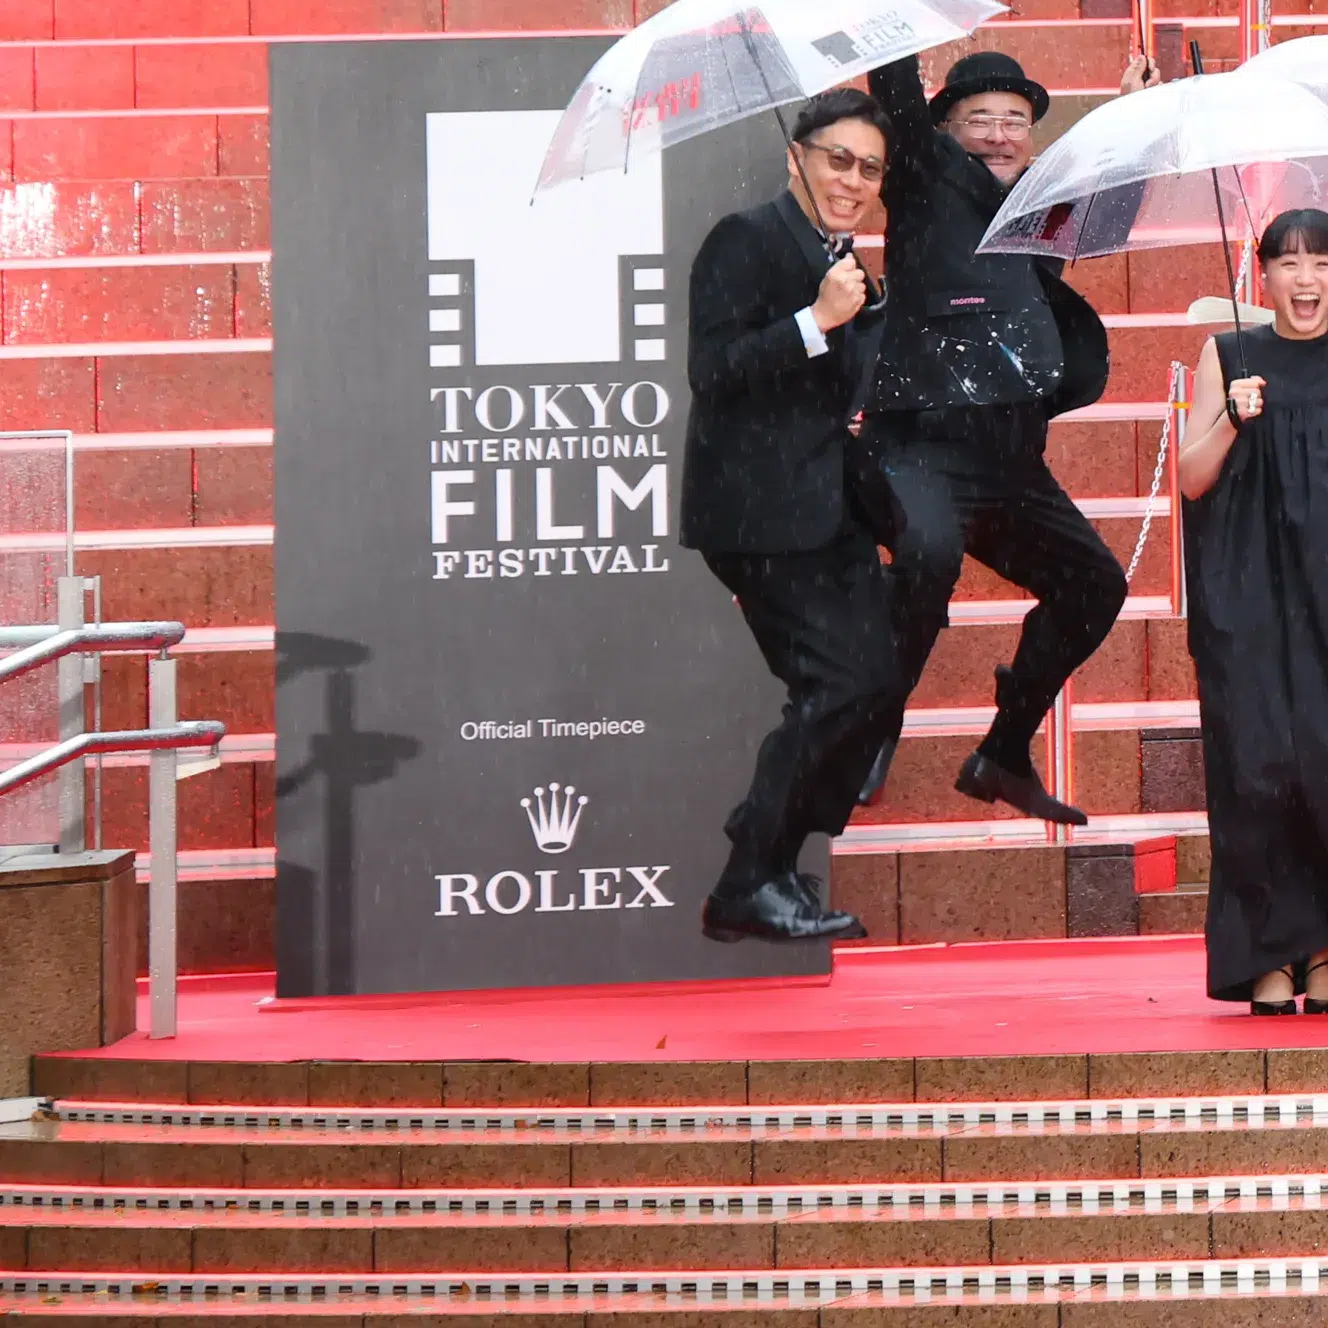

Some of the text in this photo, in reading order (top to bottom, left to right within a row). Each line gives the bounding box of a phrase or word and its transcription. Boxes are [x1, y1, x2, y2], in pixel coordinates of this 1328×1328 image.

[861, 21, 916, 53] FILM
[429, 380, 670, 434] TOKYO
[430, 433, 668, 464] INTERNATIONAL
[431, 463, 669, 545] FILM
[432, 544, 670, 580] FESTIVAL
[460, 717, 646, 740] Official Timepiece
[434, 865, 676, 917] ROLEX
